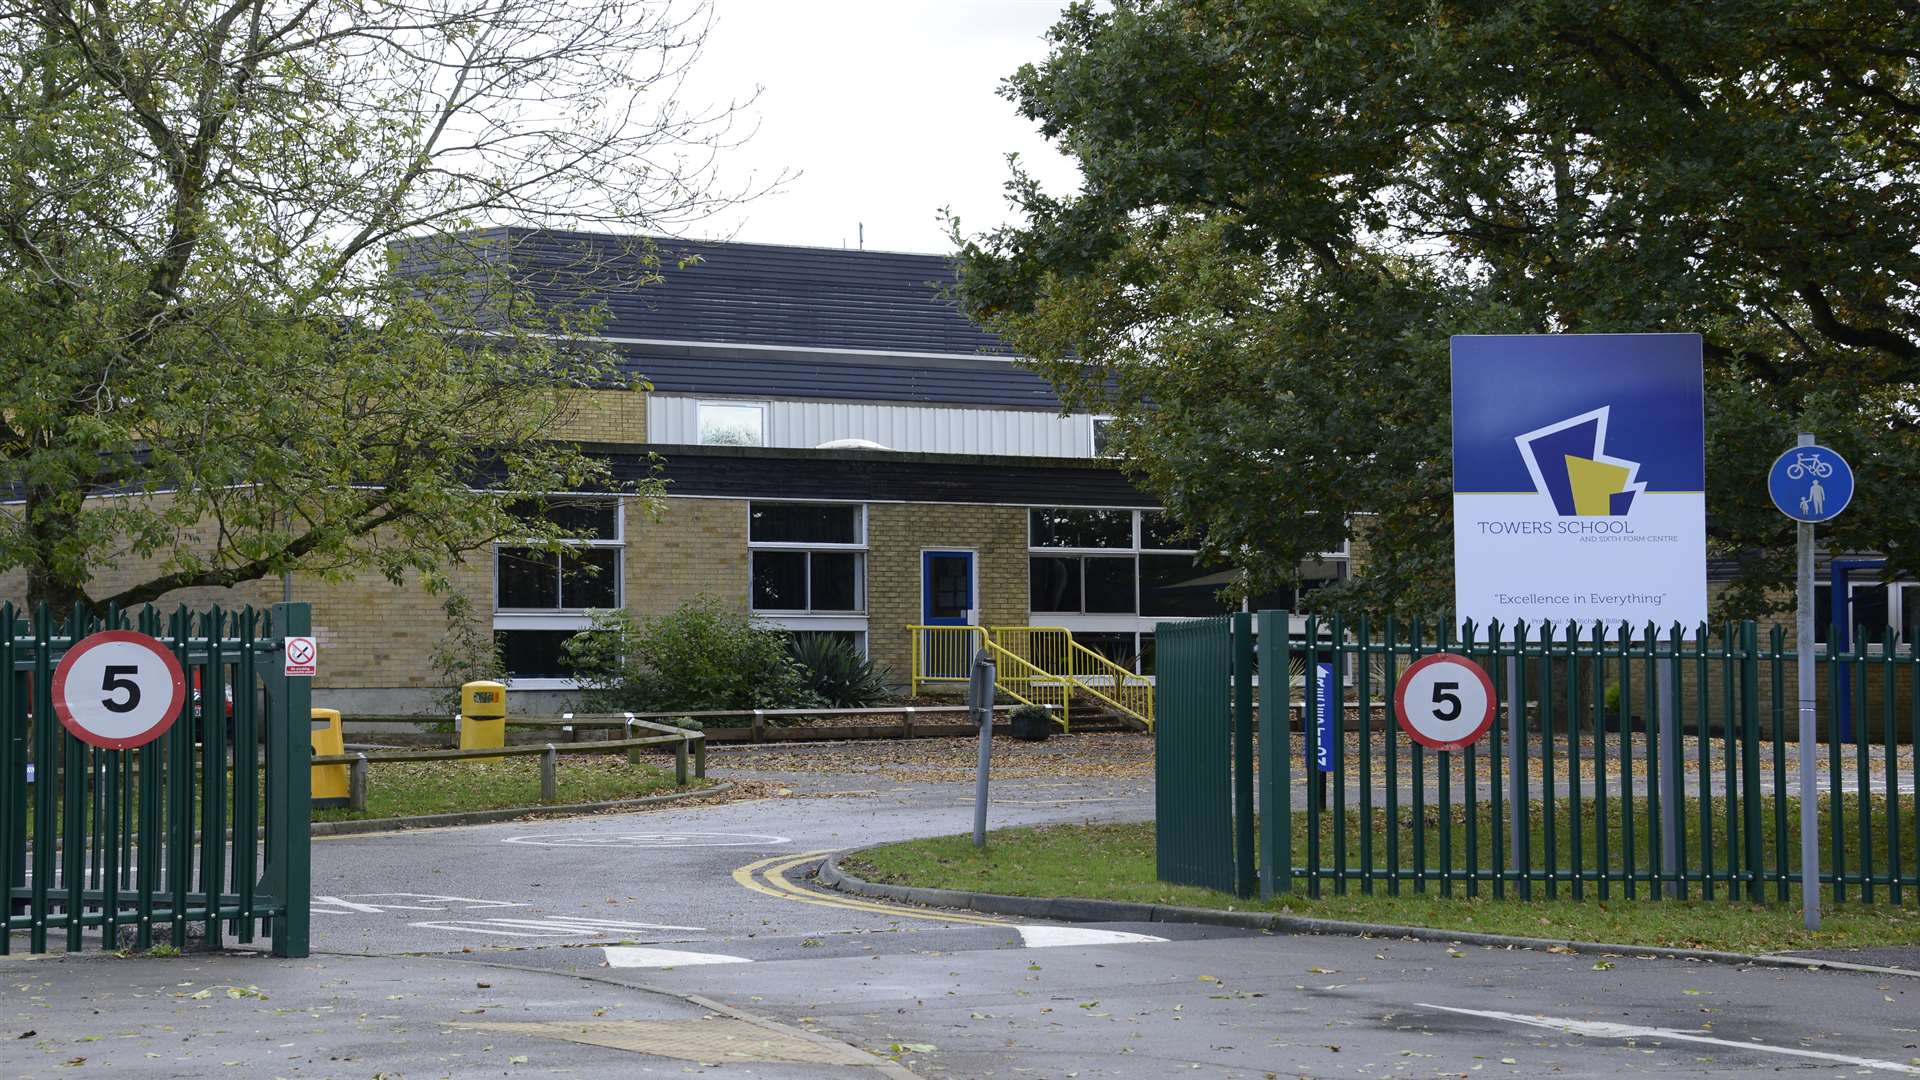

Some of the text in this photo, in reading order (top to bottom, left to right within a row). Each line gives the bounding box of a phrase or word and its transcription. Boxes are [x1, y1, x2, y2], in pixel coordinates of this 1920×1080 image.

[1477, 520, 1634, 534] TOWERS SCHOOL
[1579, 535, 1679, 543] AND SIXTH FORM CENTRE
[1494, 592, 1668, 607] "Excellence in Everything"
[101, 664, 141, 714] 5
[1432, 682, 1462, 721] 5
